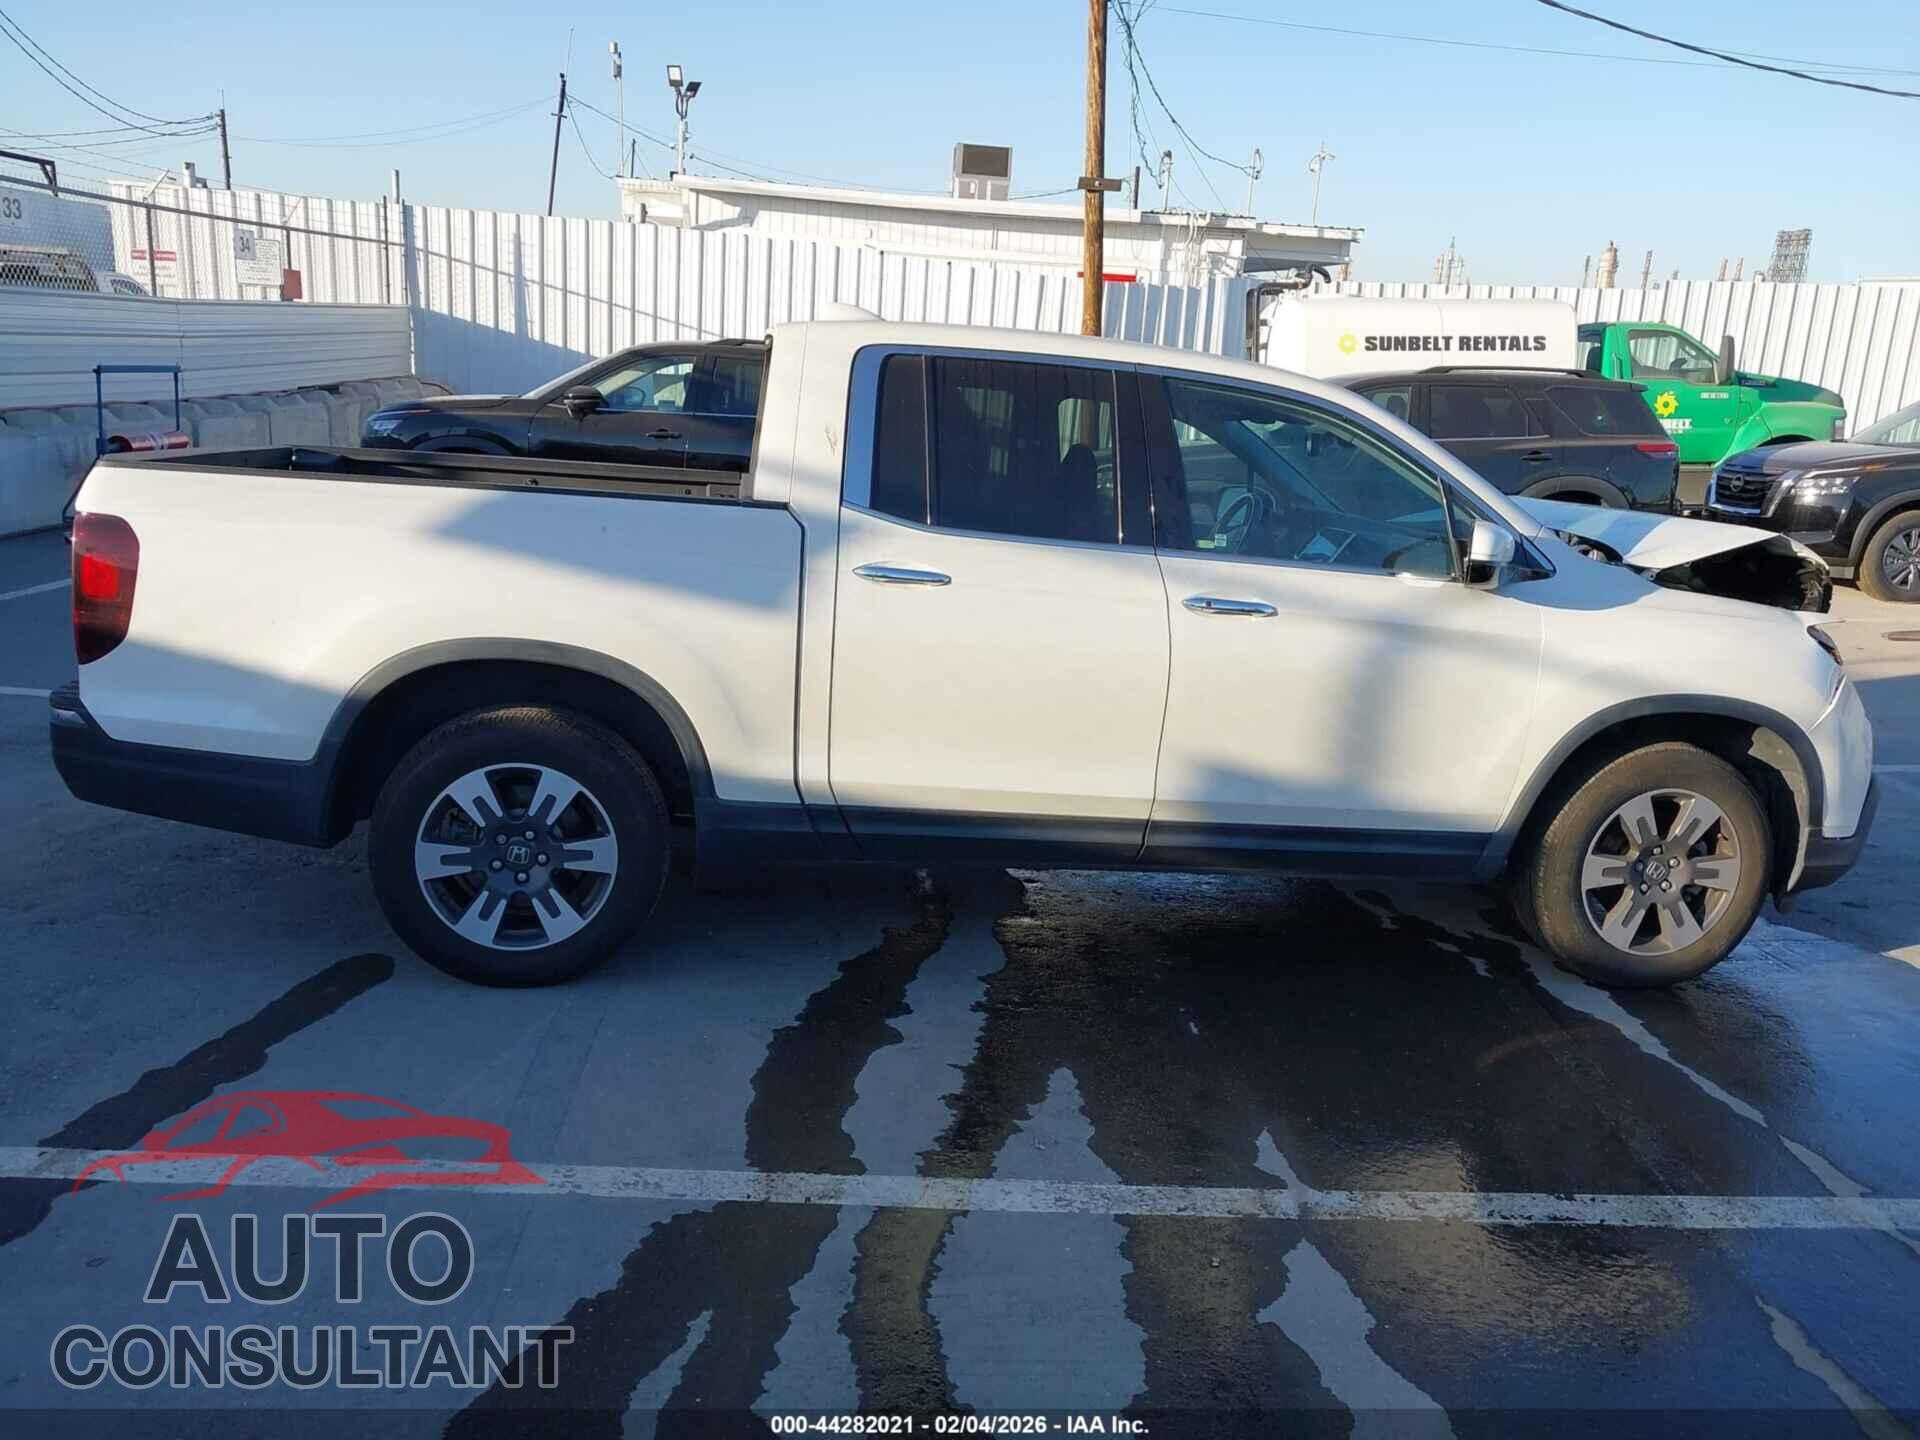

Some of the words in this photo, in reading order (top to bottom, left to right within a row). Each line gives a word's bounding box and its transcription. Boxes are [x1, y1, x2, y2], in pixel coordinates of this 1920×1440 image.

[2, 196, 22, 219] 33
[239, 236, 250, 252] 34
[1364, 335, 1453, 351] SUNBELT
[1458, 335, 1546, 351] RENTALS
